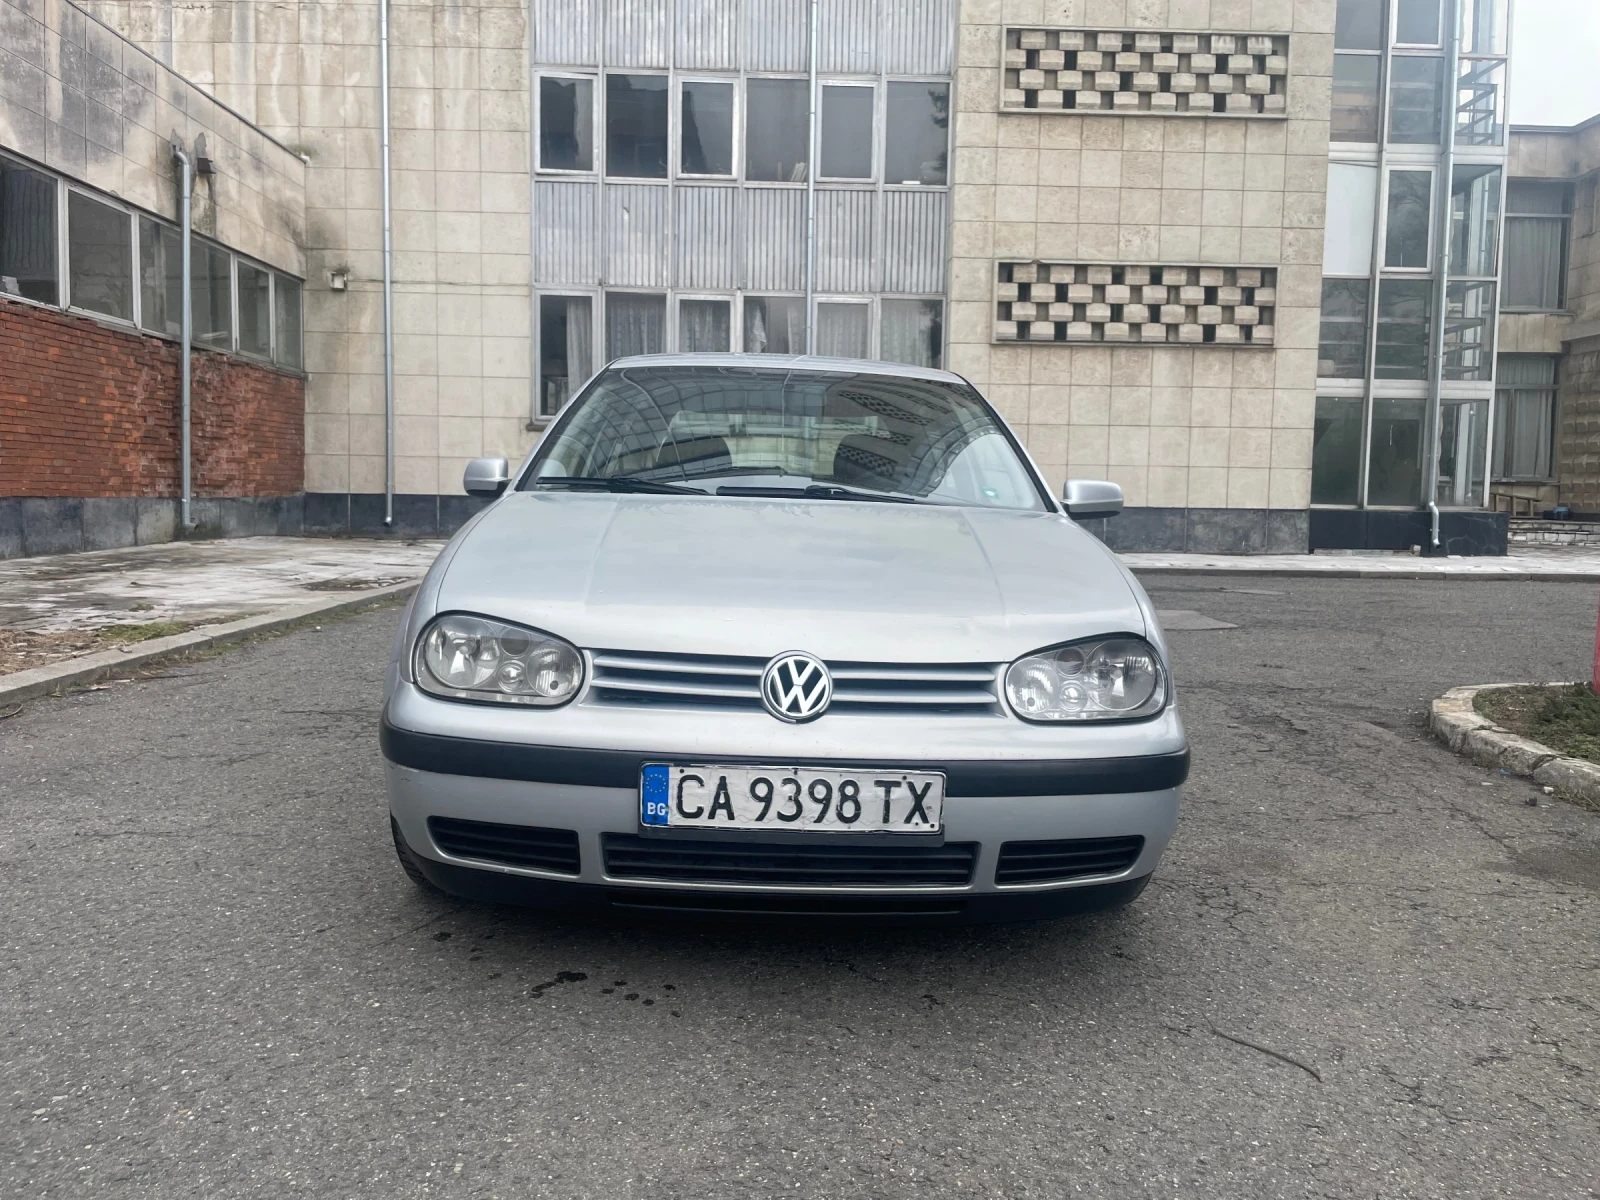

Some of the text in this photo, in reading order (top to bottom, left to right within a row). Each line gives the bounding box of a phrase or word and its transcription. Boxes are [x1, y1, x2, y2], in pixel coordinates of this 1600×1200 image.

[647, 803, 667, 816] BG
[676, 774, 933, 825] CA 9398 TX
